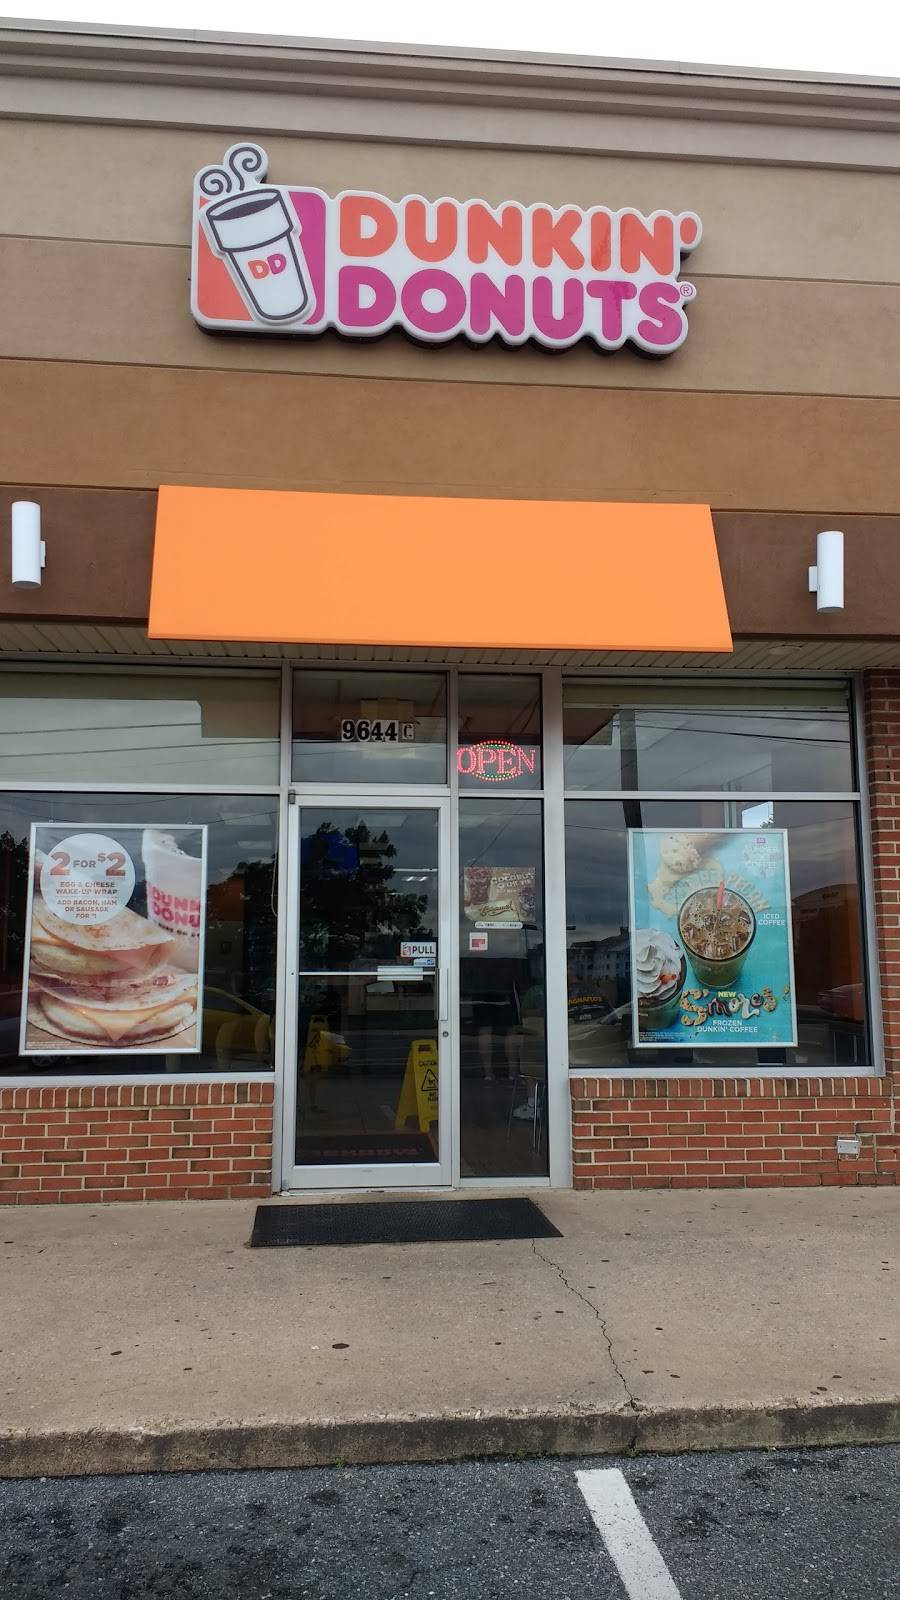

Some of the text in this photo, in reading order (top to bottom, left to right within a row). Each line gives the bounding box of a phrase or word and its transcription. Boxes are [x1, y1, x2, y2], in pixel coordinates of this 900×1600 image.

[338, 194, 698, 277] DUNKIN'
[247, 253, 287, 280] DD
[338, 265, 683, 345] DONUTS
[342, 720, 413, 741] 9644 C
[456, 749, 536, 774] OPEN
[50, 851, 71, 876] 2
[73, 860, 97, 868] FOR
[412, 945, 435, 954] PULL
